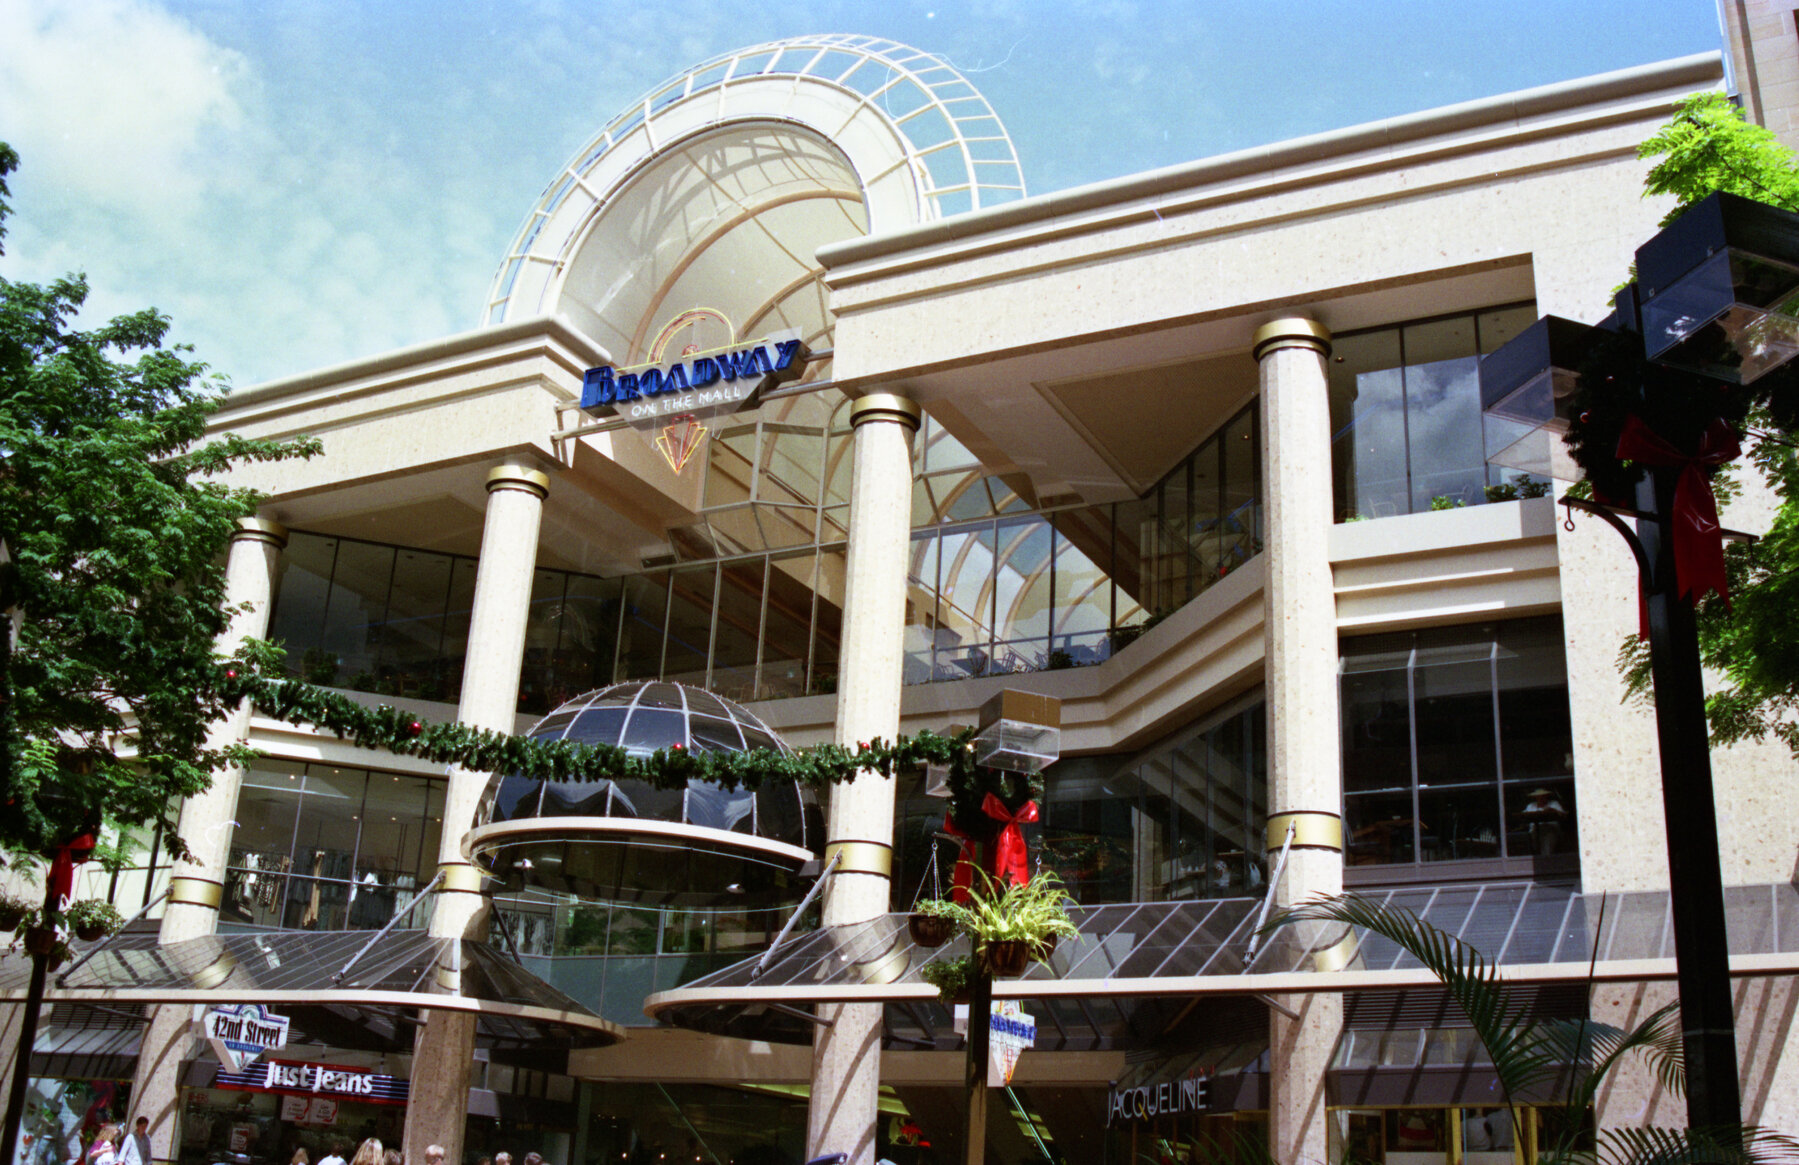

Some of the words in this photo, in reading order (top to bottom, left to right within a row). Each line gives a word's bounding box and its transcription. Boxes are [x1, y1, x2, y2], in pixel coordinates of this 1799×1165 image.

[580, 339, 801, 409] BROADWAY
[631, 403, 657, 418] ON
[663, 394, 693, 412] THE
[698, 386, 741, 404] MALL
[213, 1015, 243, 1041] 42nd
[245, 1020, 281, 1047] Street
[264, 1061, 309, 1089] Just
[312, 1066, 373, 1093] Jeans
[1106, 1076, 1207, 1128] JACQUELINE
